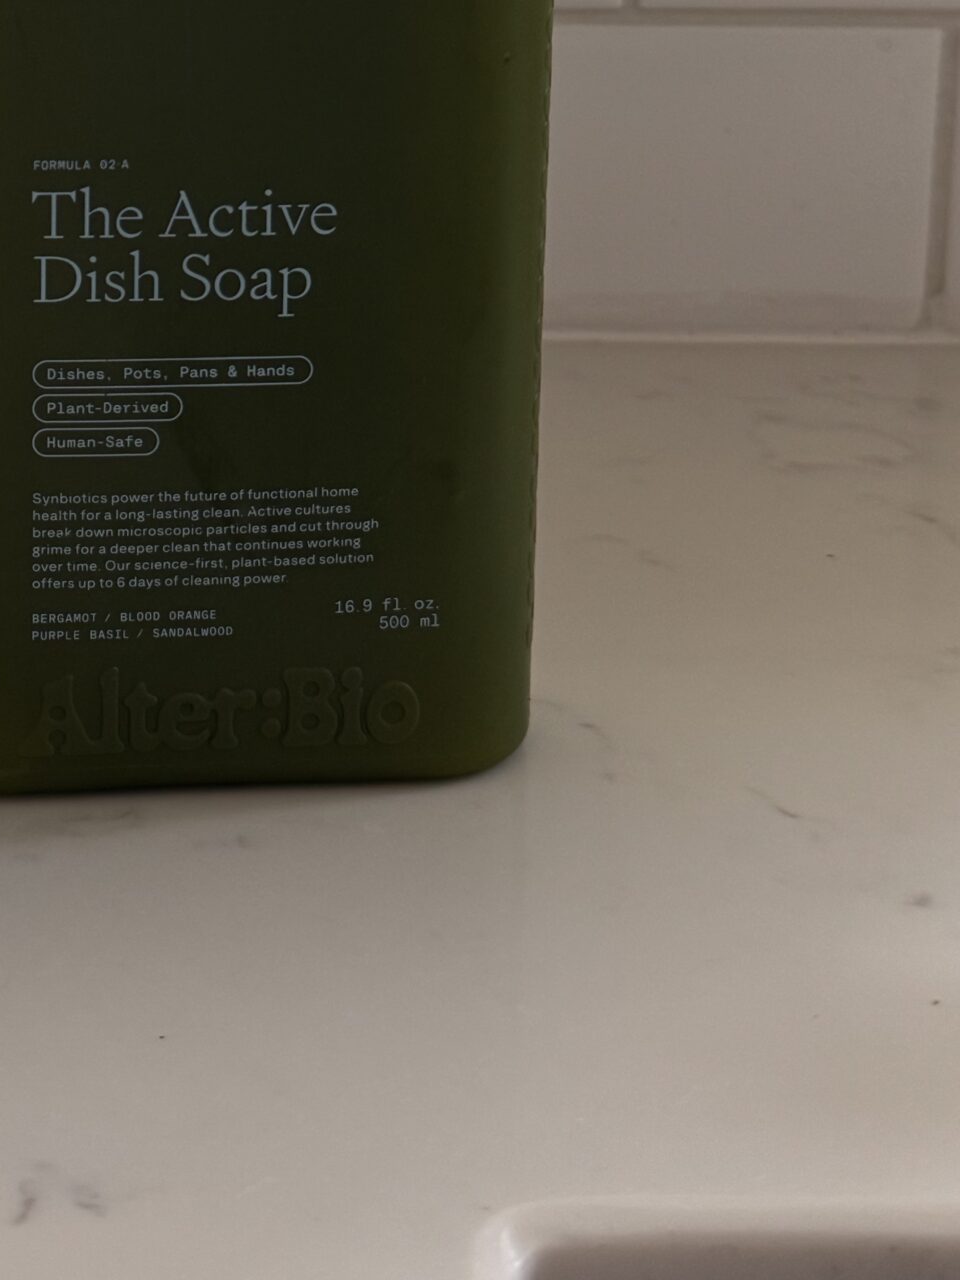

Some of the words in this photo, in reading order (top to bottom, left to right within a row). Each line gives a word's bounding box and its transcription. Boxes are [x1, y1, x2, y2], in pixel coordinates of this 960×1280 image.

[33, 160, 91, 171] FORMULA
[32, 186, 143, 239] The
[158, 189, 338, 238] Active
[33, 250, 164, 303] Dish
[180, 254, 312, 317] Soap
[180, 366, 218, 378] Pans
[228, 365, 237, 378] &
[247, 364, 294, 376] Hands
[46, 400, 169, 414] Plant-Derived
[46, 436, 144, 448] Human-Safe
[32, 492, 108, 506] Synbiotics
[111, 494, 154, 506] power
[158, 491, 180, 502] the
[184, 490, 227, 502] future
[230, 489, 244, 500] of
[247, 487, 318, 500] functional
[322, 487, 359, 497] home
[33, 510, 76, 521] health
[80, 510, 101, 520] for
[104, 512, 112, 520] a
[116, 508, 199, 522] long-lasting
[248, 506, 292, 516] Active
[295, 504, 351, 515] cultures
[32, 527, 71, 538] break
[76, 528, 113, 538] down
[118, 527, 202, 538] microscopic
[206, 523, 267, 537] particles
[271, 522, 296, 533] and
[300, 522, 322, 532] cut
[326, 518, 379, 532] through
[32, 544, 72, 558] grime
[76, 544, 94, 554] for
[98, 546, 106, 554] a
[110, 544, 159, 556] deeper
[162, 542, 200, 552] clean
[203, 541, 232, 552] that
[236, 540, 303, 551] continues
[307, 537, 360, 549] working
[32, 564, 63, 572] over
[105, 560, 130, 571] Our
[232, 554, 315, 570] plant-based
[320, 553, 374, 564] solution
[32, 578, 74, 589] offers
[78, 580, 96, 590] up
[99, 578, 114, 588] to
[117, 577, 125, 588] 6
[129, 576, 161, 590] days
[164, 575, 178, 586] of
[182, 575, 240, 587] cleaning
[32, 612, 96, 624] BERGAMOT
[120, 611, 160, 622] BLOOD
[169, 610, 216, 620] ORANGE
[379, 615, 410, 630] 500
[420, 613, 440, 627] ml
[32, 630, 80, 640] PURPLE
[90, 629, 128, 640] BASIL
[153, 626, 234, 638] SANDALWOOD
[17, 666, 420, 758] Alter:Bio
